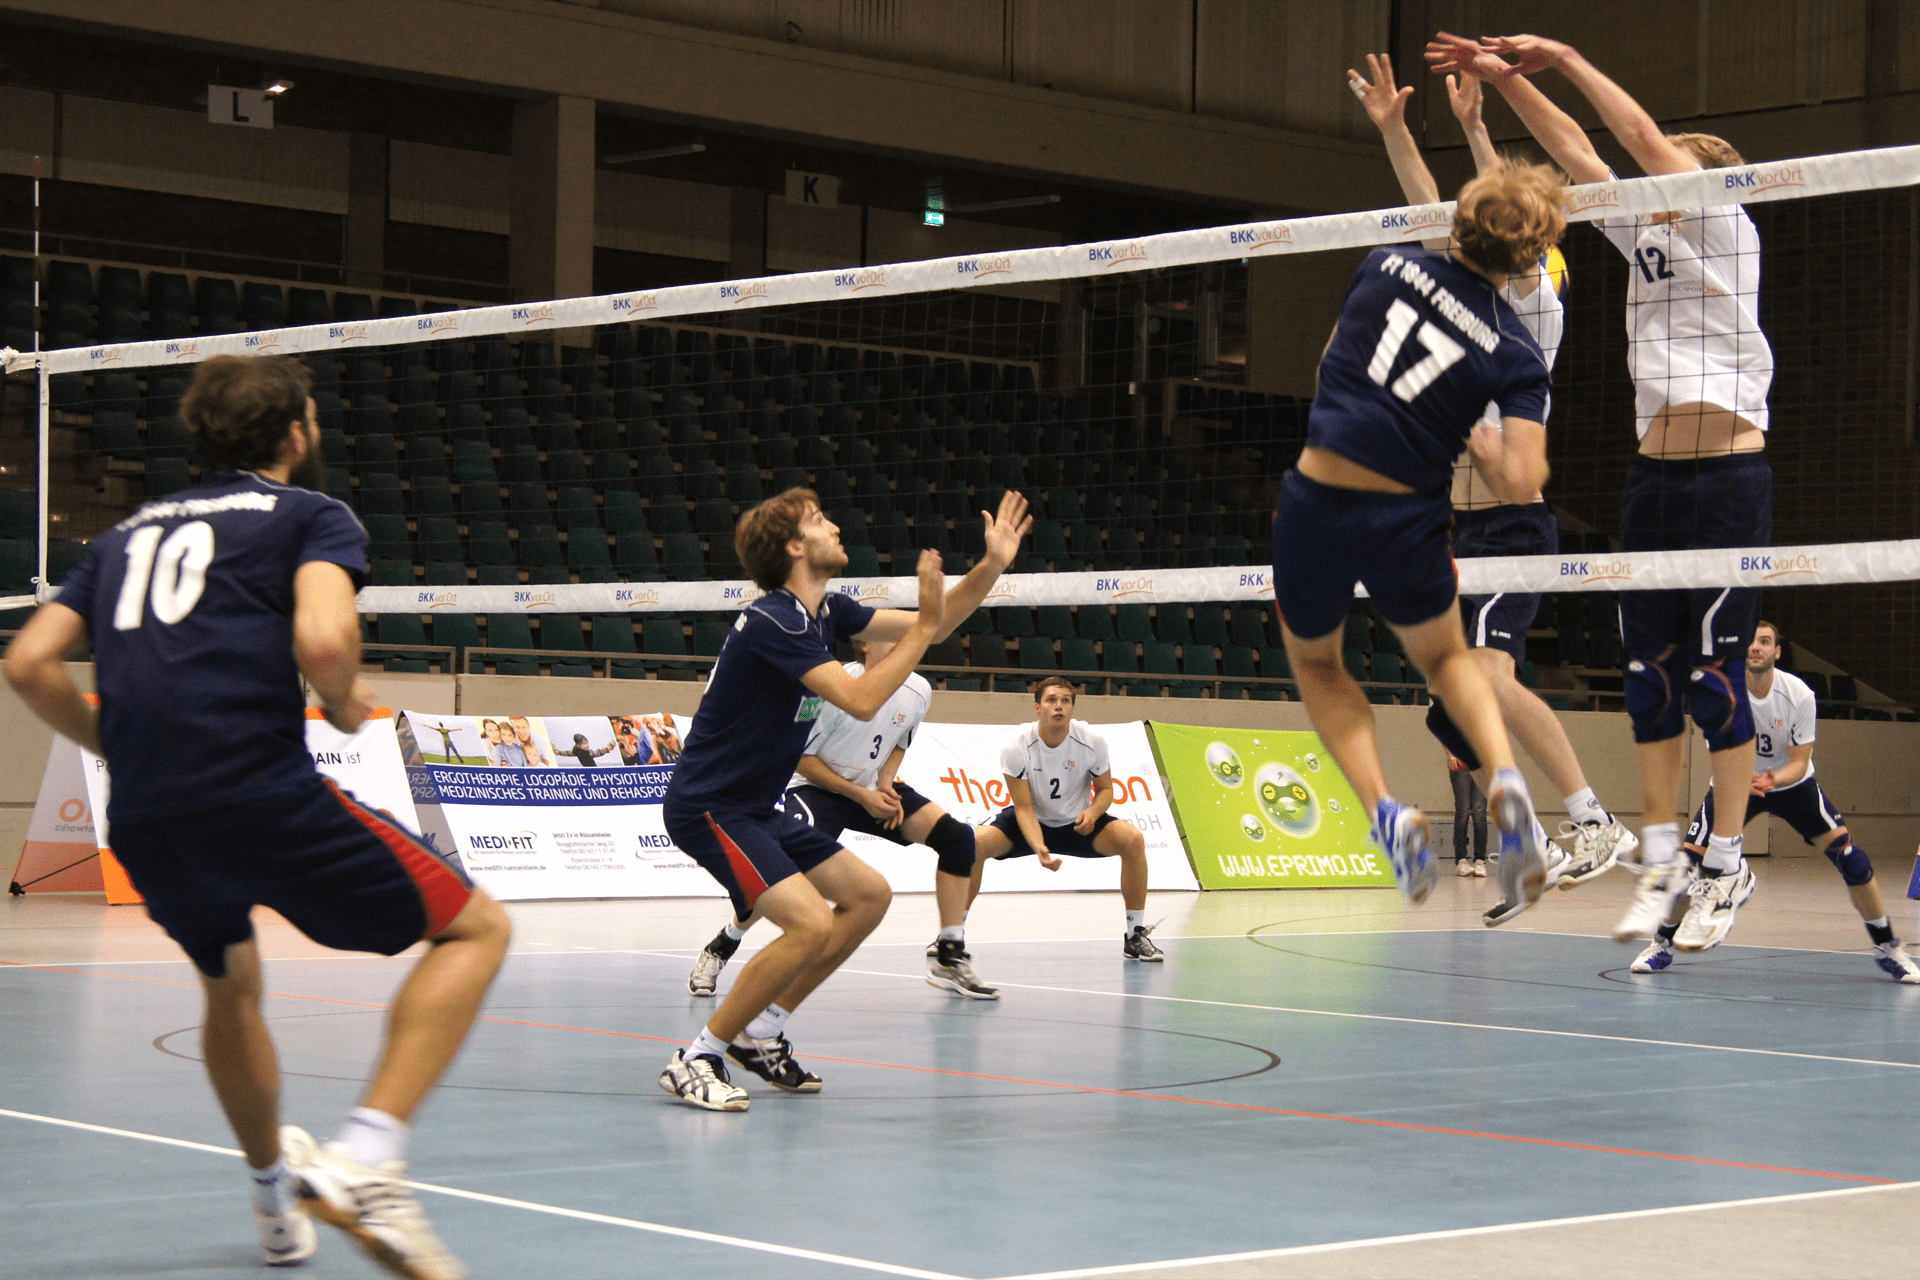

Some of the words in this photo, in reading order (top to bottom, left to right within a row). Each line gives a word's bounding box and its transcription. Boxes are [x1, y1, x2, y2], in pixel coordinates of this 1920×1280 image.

[232, 91, 250, 123] L
[1725, 172, 1756, 189] BKK
[803, 175, 820, 204] K
[1381, 213, 1408, 229] BKK
[1230, 229, 1255, 244] BKK
[1089, 247, 1112, 261] BKK
[957, 260, 978, 273] BKK
[1634, 246, 1675, 284] 12
[835, 274, 855, 287] BKK
[720, 286, 739, 298] BKK
[613, 298, 630, 310] BKK
[512, 308, 529, 319] BKK
[1430, 286, 1500, 354] FREIBURG
[417, 319, 433, 329] BKK
[330, 327, 345, 338] BKK
[1367, 297, 1467, 403] 17
[1560, 562, 1589, 576] BKK
[1740, 556, 1772, 570] BKK
[112, 520, 216, 632] 10
[1239, 573, 1264, 586] BKK
[840, 585, 860, 597] BKK
[1096, 579, 1120, 591] BKK
[418, 592, 435, 603] BKK
[514, 591, 531, 602] BKK
[615, 589, 633, 600] BKK
[724, 587, 742, 598] BKK
[869, 734, 882, 760] 3
[1755, 732, 1773, 753] 13
[345, 752, 361, 764] ist
[433, 770, 524, 788] ERGOTHERAPIE,
[524, 771, 591, 787] LOGOPÄDIE,
[439, 785, 527, 800] MEDIZINISCHES
[527, 787, 583, 801] TRAINING
[584, 787, 610, 800] UND
[1050, 778, 1061, 800] 2
[1688, 822, 1700, 836] 13
[1217, 854, 1382, 877] WWW.EPRIMO.DE
